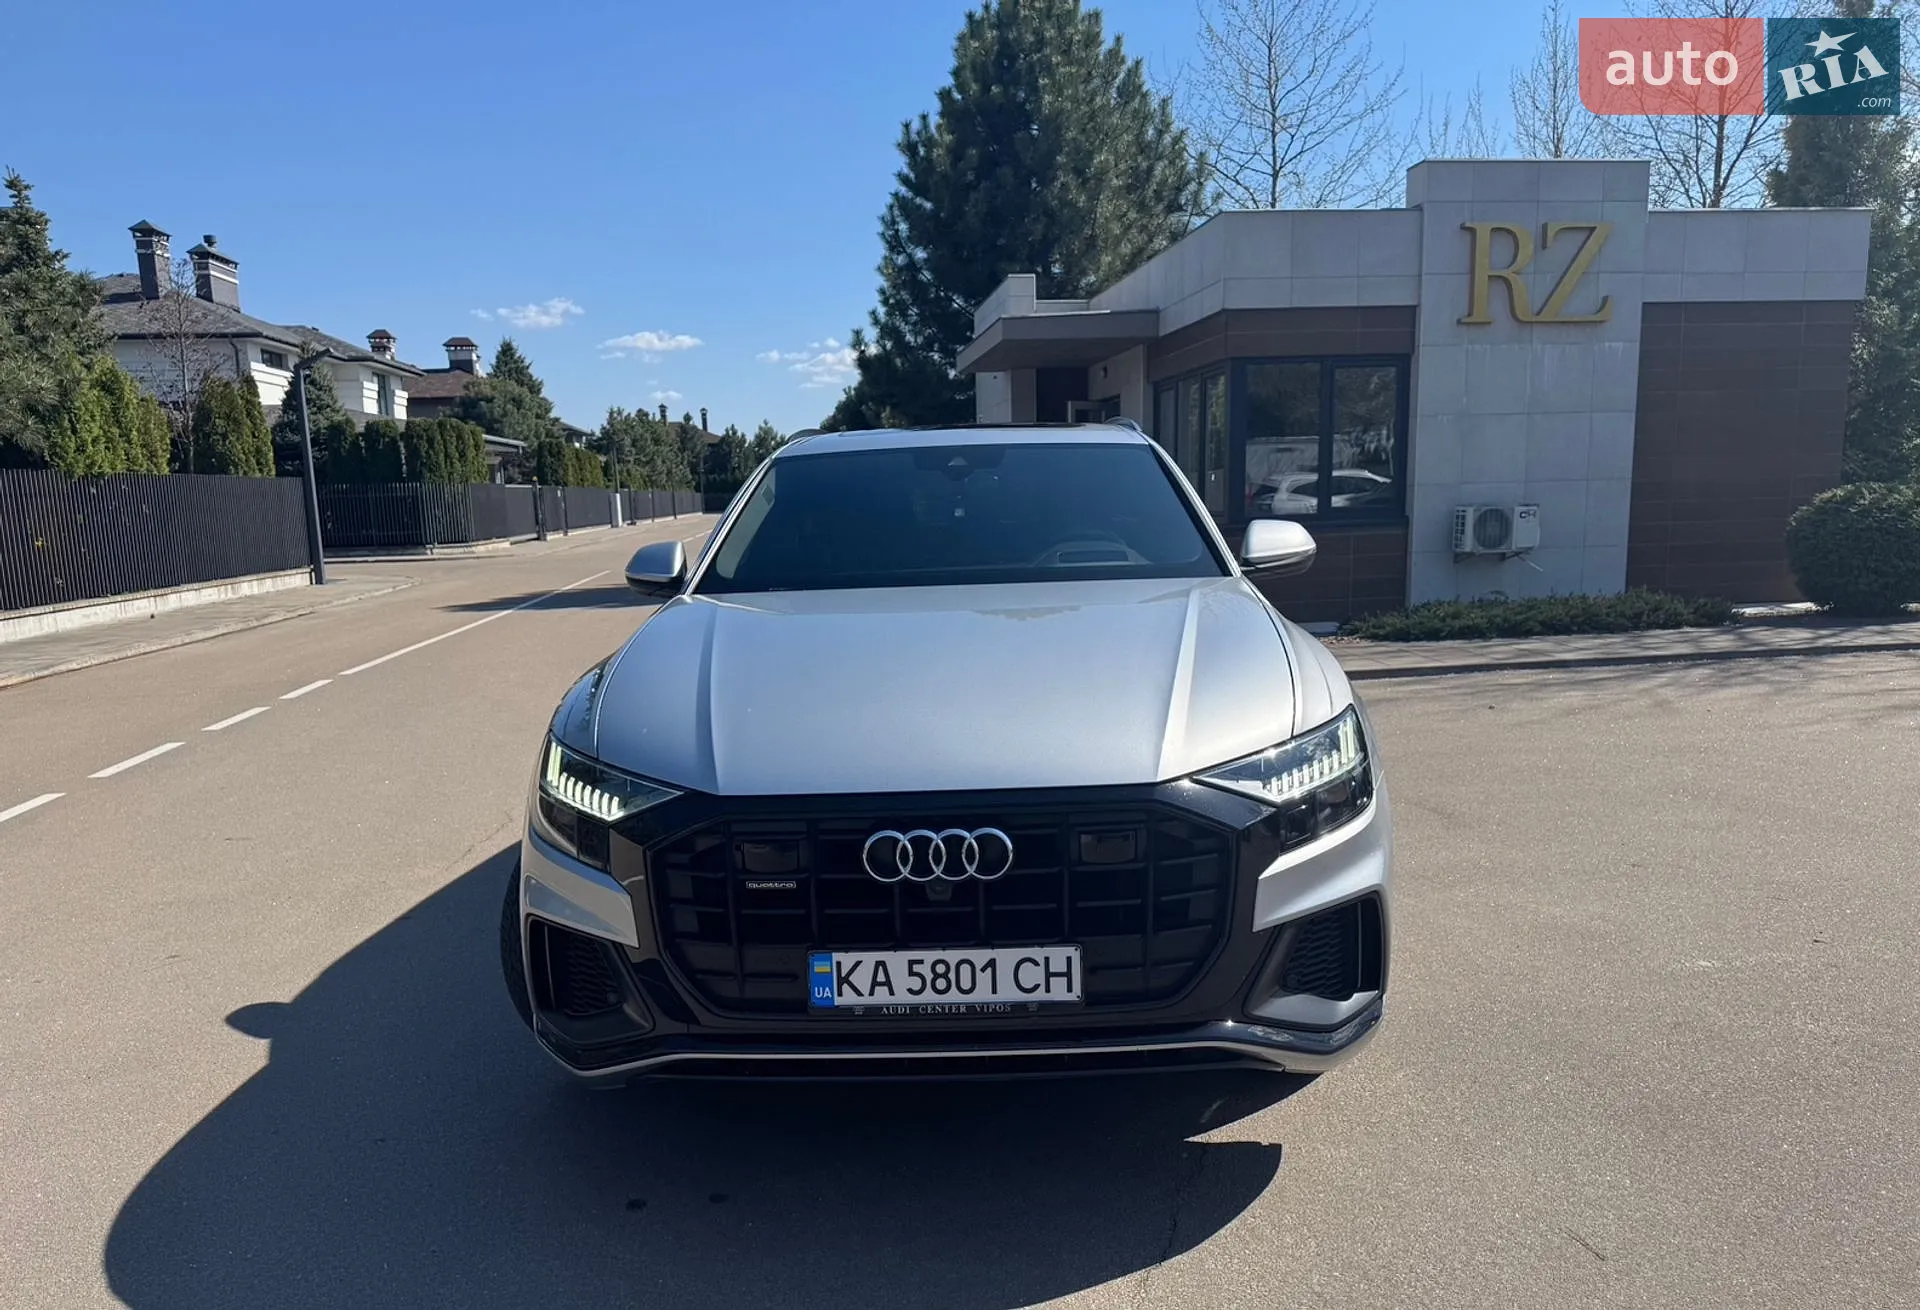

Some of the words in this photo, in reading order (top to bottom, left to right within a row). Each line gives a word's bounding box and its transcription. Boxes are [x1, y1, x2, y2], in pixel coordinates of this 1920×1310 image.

[1457, 222, 1614, 325] RZ
[748, 881, 794, 889] quattro
[836, 959, 896, 998] KA
[906, 957, 998, 996] 5801
[1012, 955, 1073, 995] CH
[815, 986, 832, 998] UA
[880, 1005, 911, 1015] AUDI
[919, 1004, 968, 1014] CENTER
[974, 1002, 1012, 1013] VIPOS
